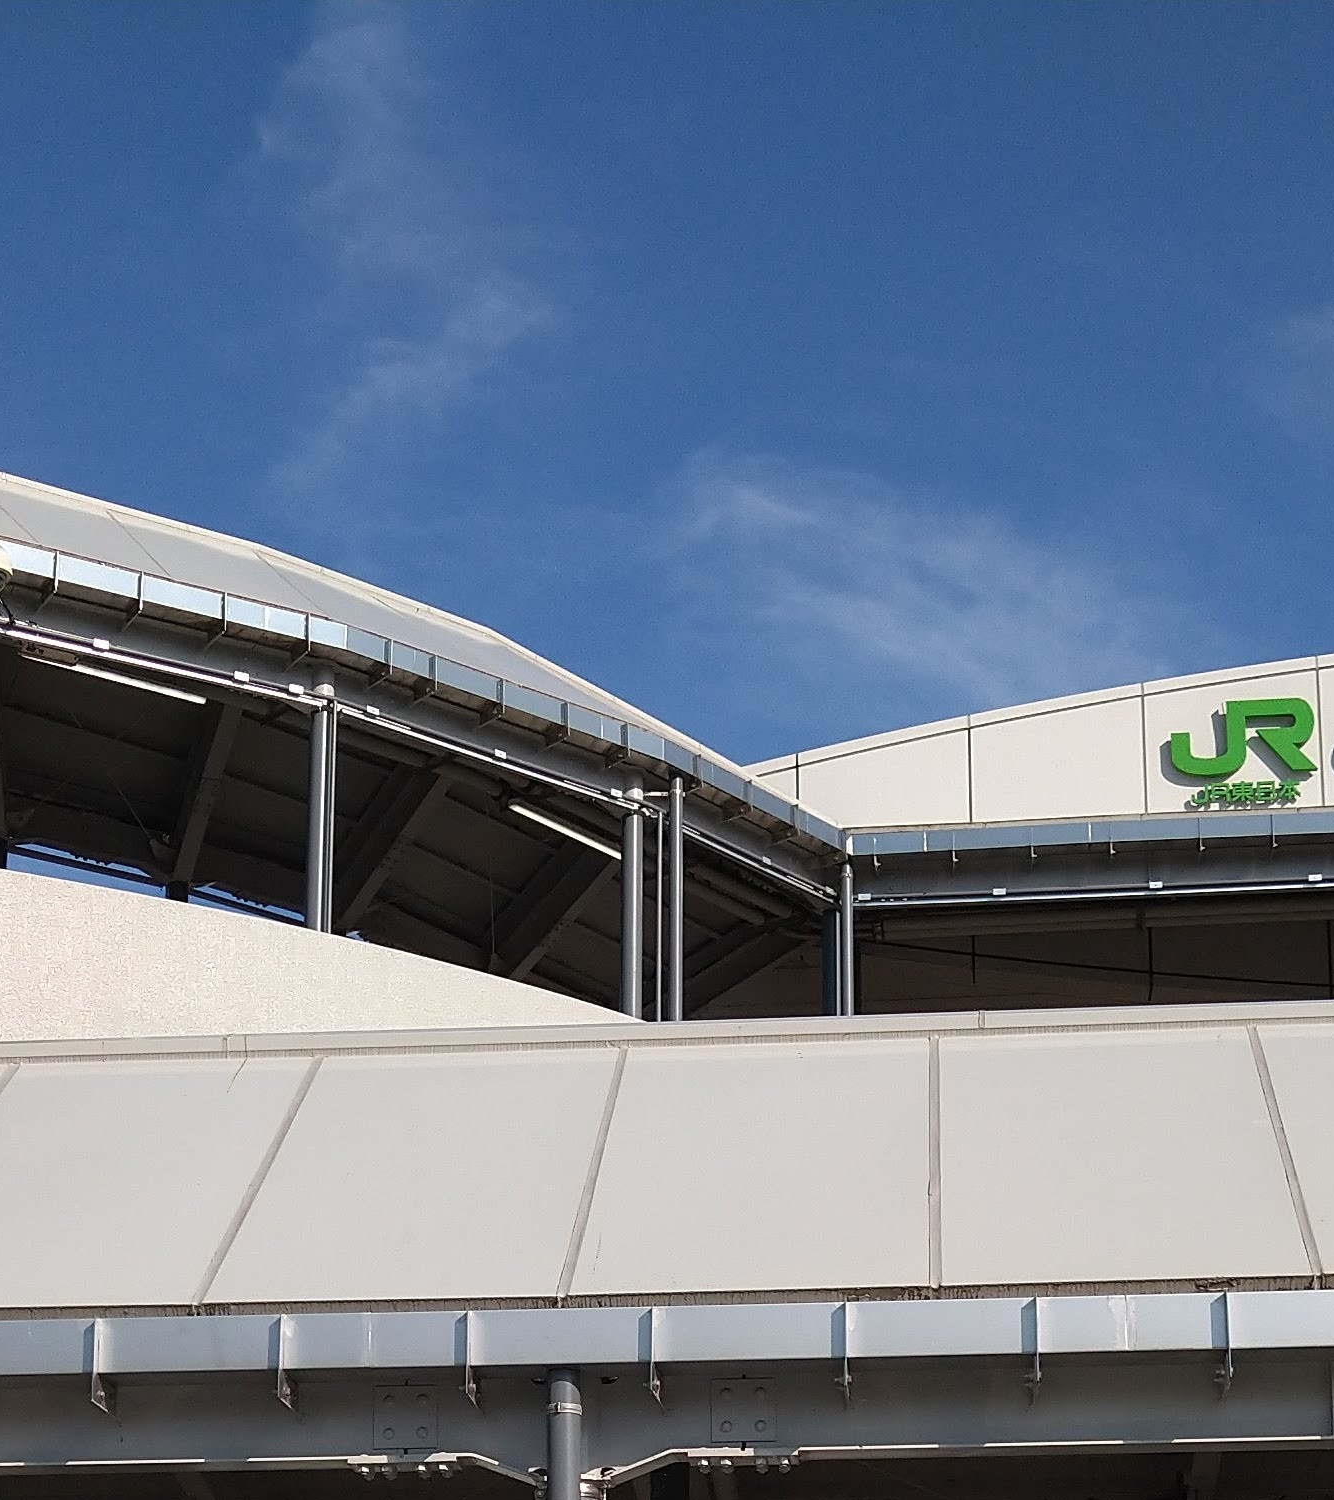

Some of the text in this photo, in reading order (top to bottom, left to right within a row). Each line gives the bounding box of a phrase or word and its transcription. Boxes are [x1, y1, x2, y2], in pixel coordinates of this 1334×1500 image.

[1170, 697, 1319, 777] JR
[1191, 780, 1302, 805] JR東日本
